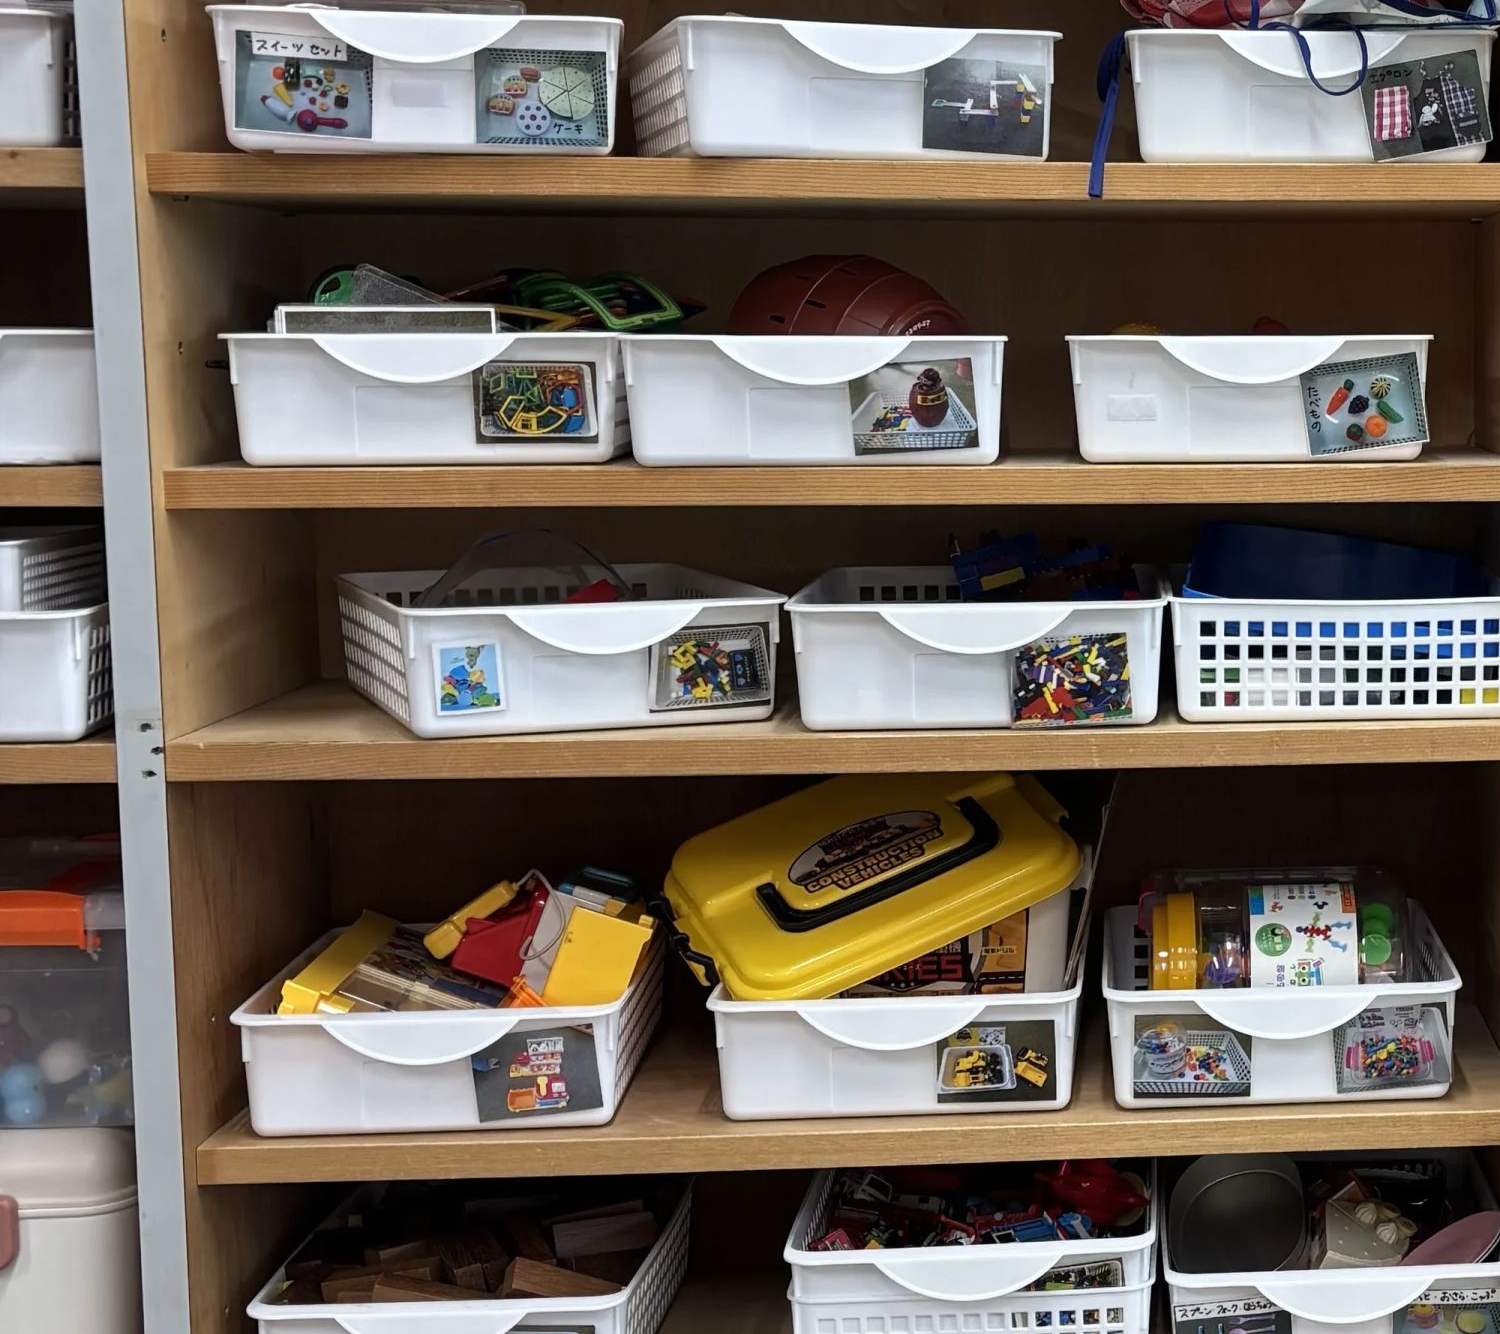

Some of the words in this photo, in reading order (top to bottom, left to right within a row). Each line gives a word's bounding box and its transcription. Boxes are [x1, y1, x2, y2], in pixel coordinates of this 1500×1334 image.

[255, 38, 304, 54] スイーツ
[309, 41, 342, 58] セット
[553, 122, 584, 135] ケーキ
[805, 828, 942, 892] CONSTRUCTION
[838, 846, 924, 889] VEHICLES
